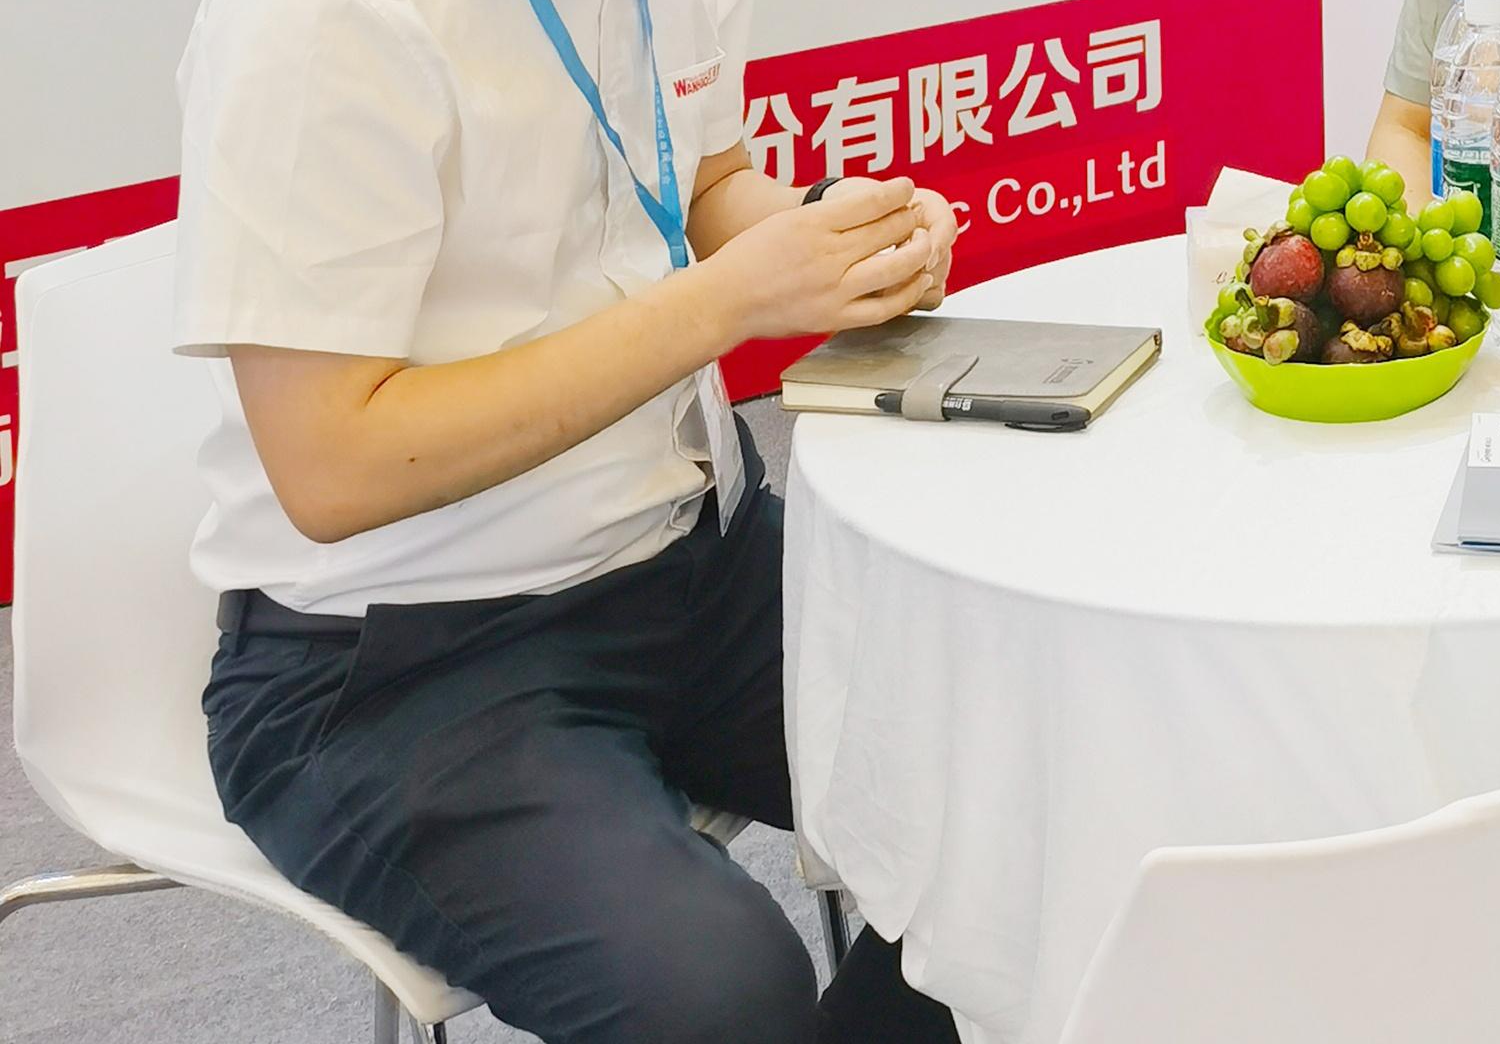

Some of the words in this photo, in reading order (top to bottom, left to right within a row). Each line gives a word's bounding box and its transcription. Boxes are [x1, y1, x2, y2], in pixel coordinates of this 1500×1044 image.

[742, 18, 1162, 188] 份有限公司
